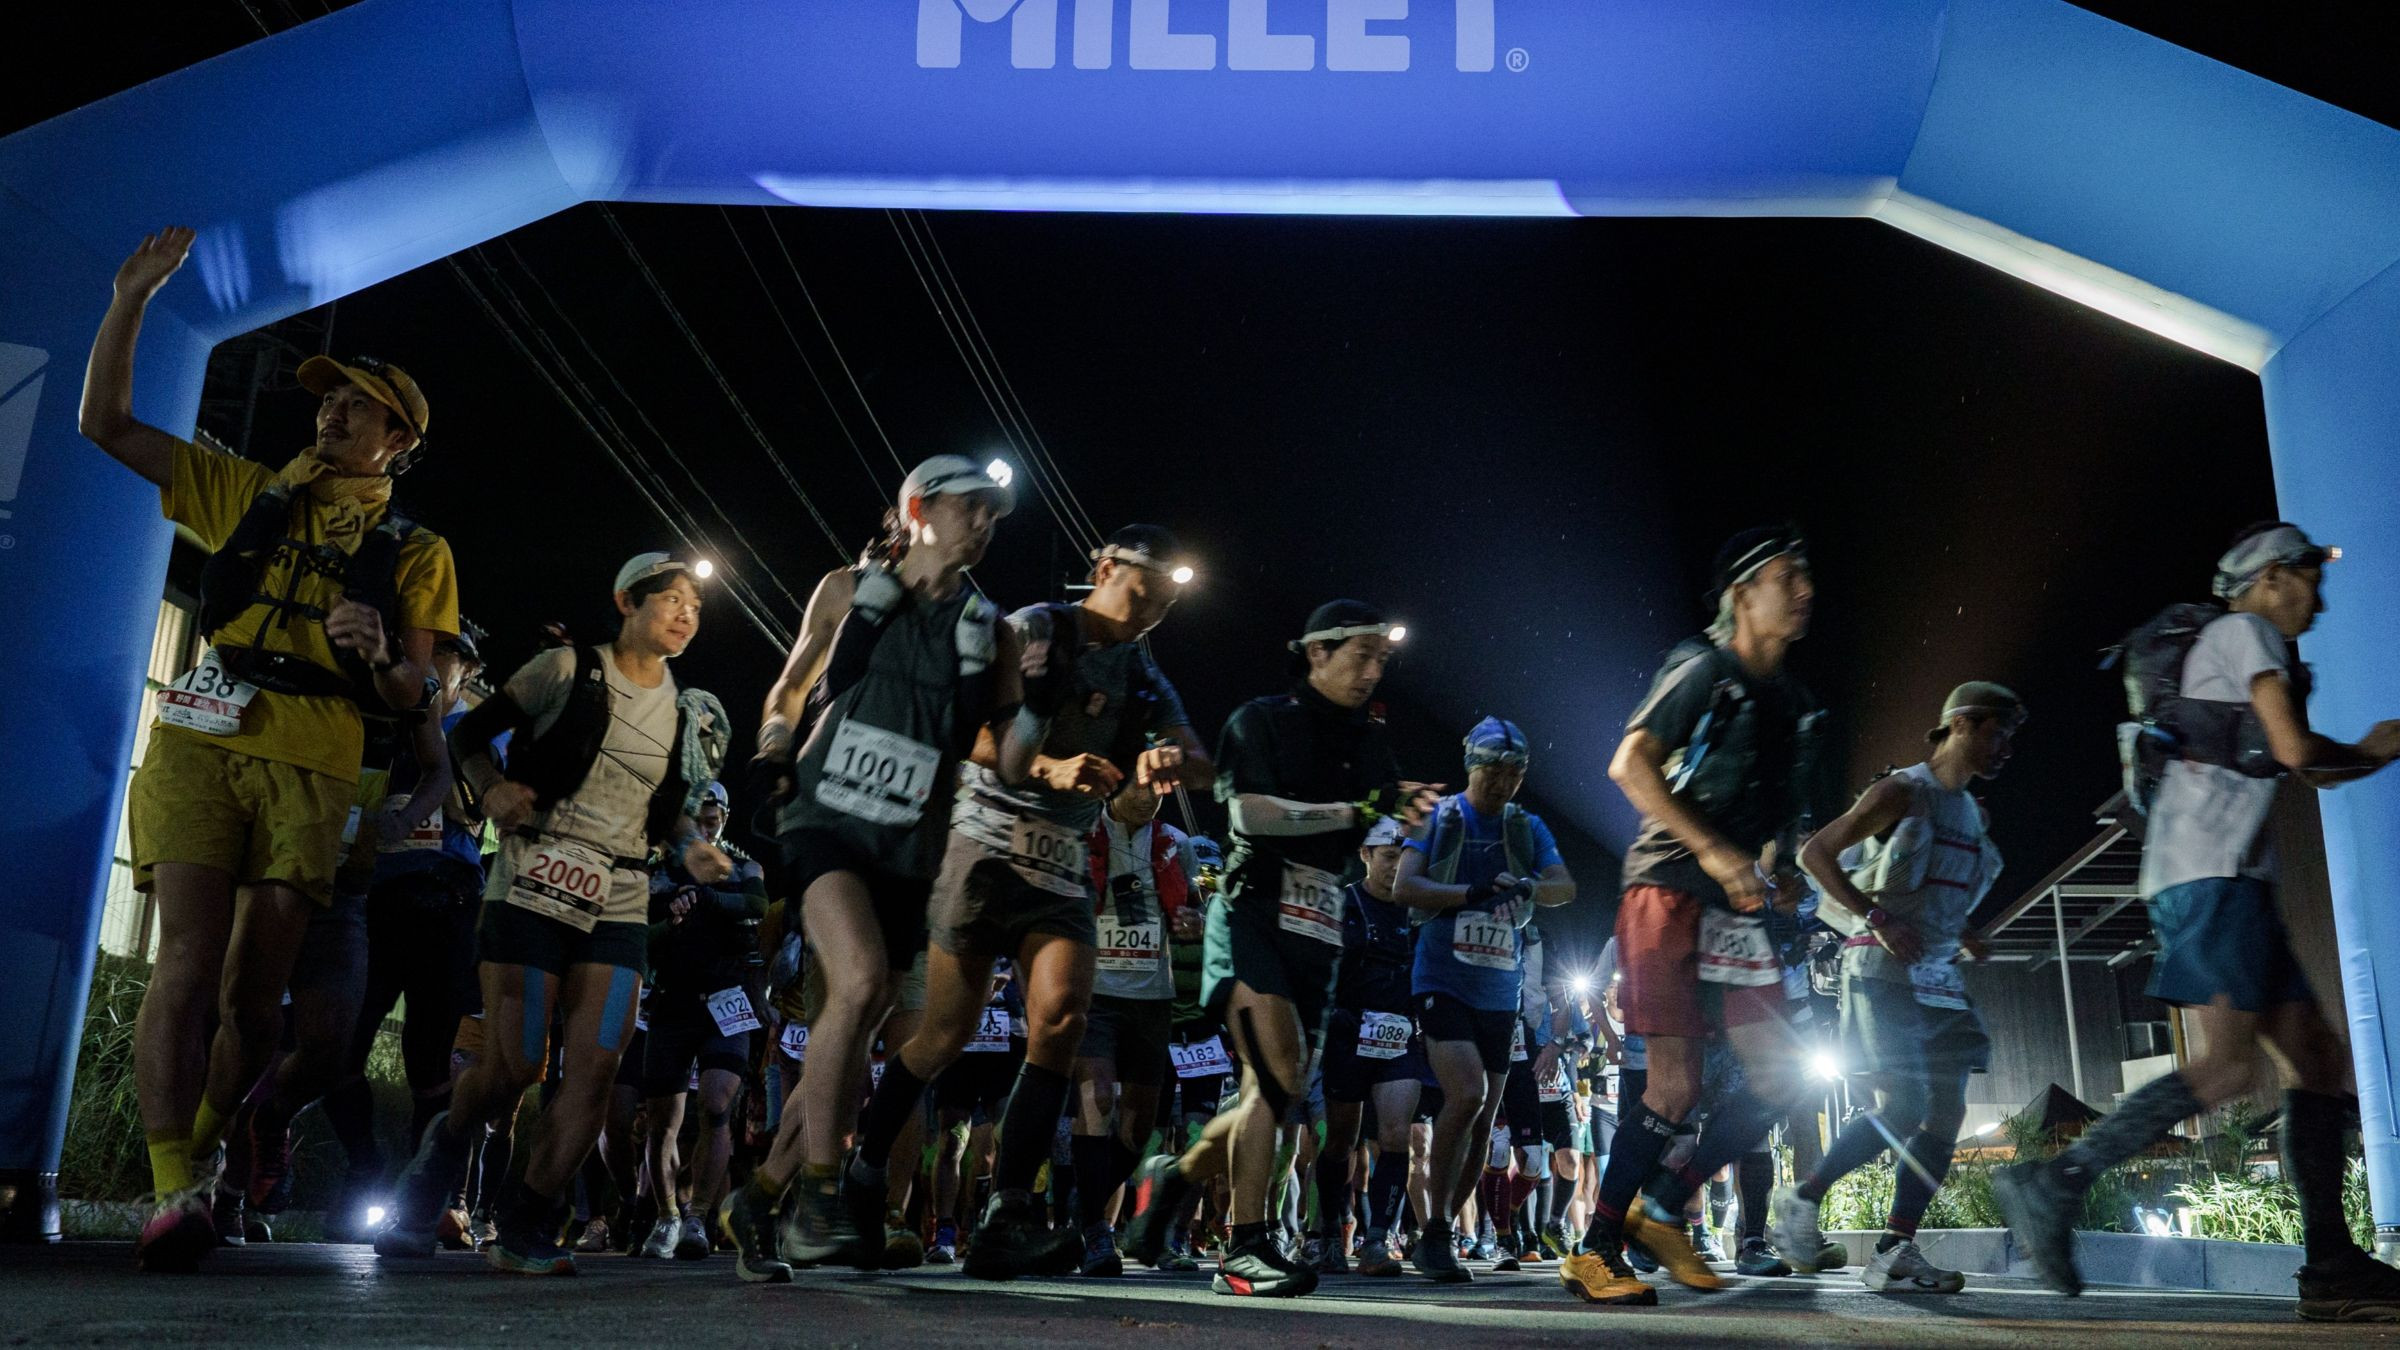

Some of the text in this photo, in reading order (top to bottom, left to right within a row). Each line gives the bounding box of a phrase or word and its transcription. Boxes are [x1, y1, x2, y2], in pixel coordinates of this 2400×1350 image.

[843, 744, 918, 795] 1001
[528, 853, 601, 898] 2000
[1105, 929, 1151, 949] 1204
[1463, 924, 1508, 946] 1177
[1368, 1024, 1405, 1041] 1088
[1177, 1046, 1217, 1064] 1183
